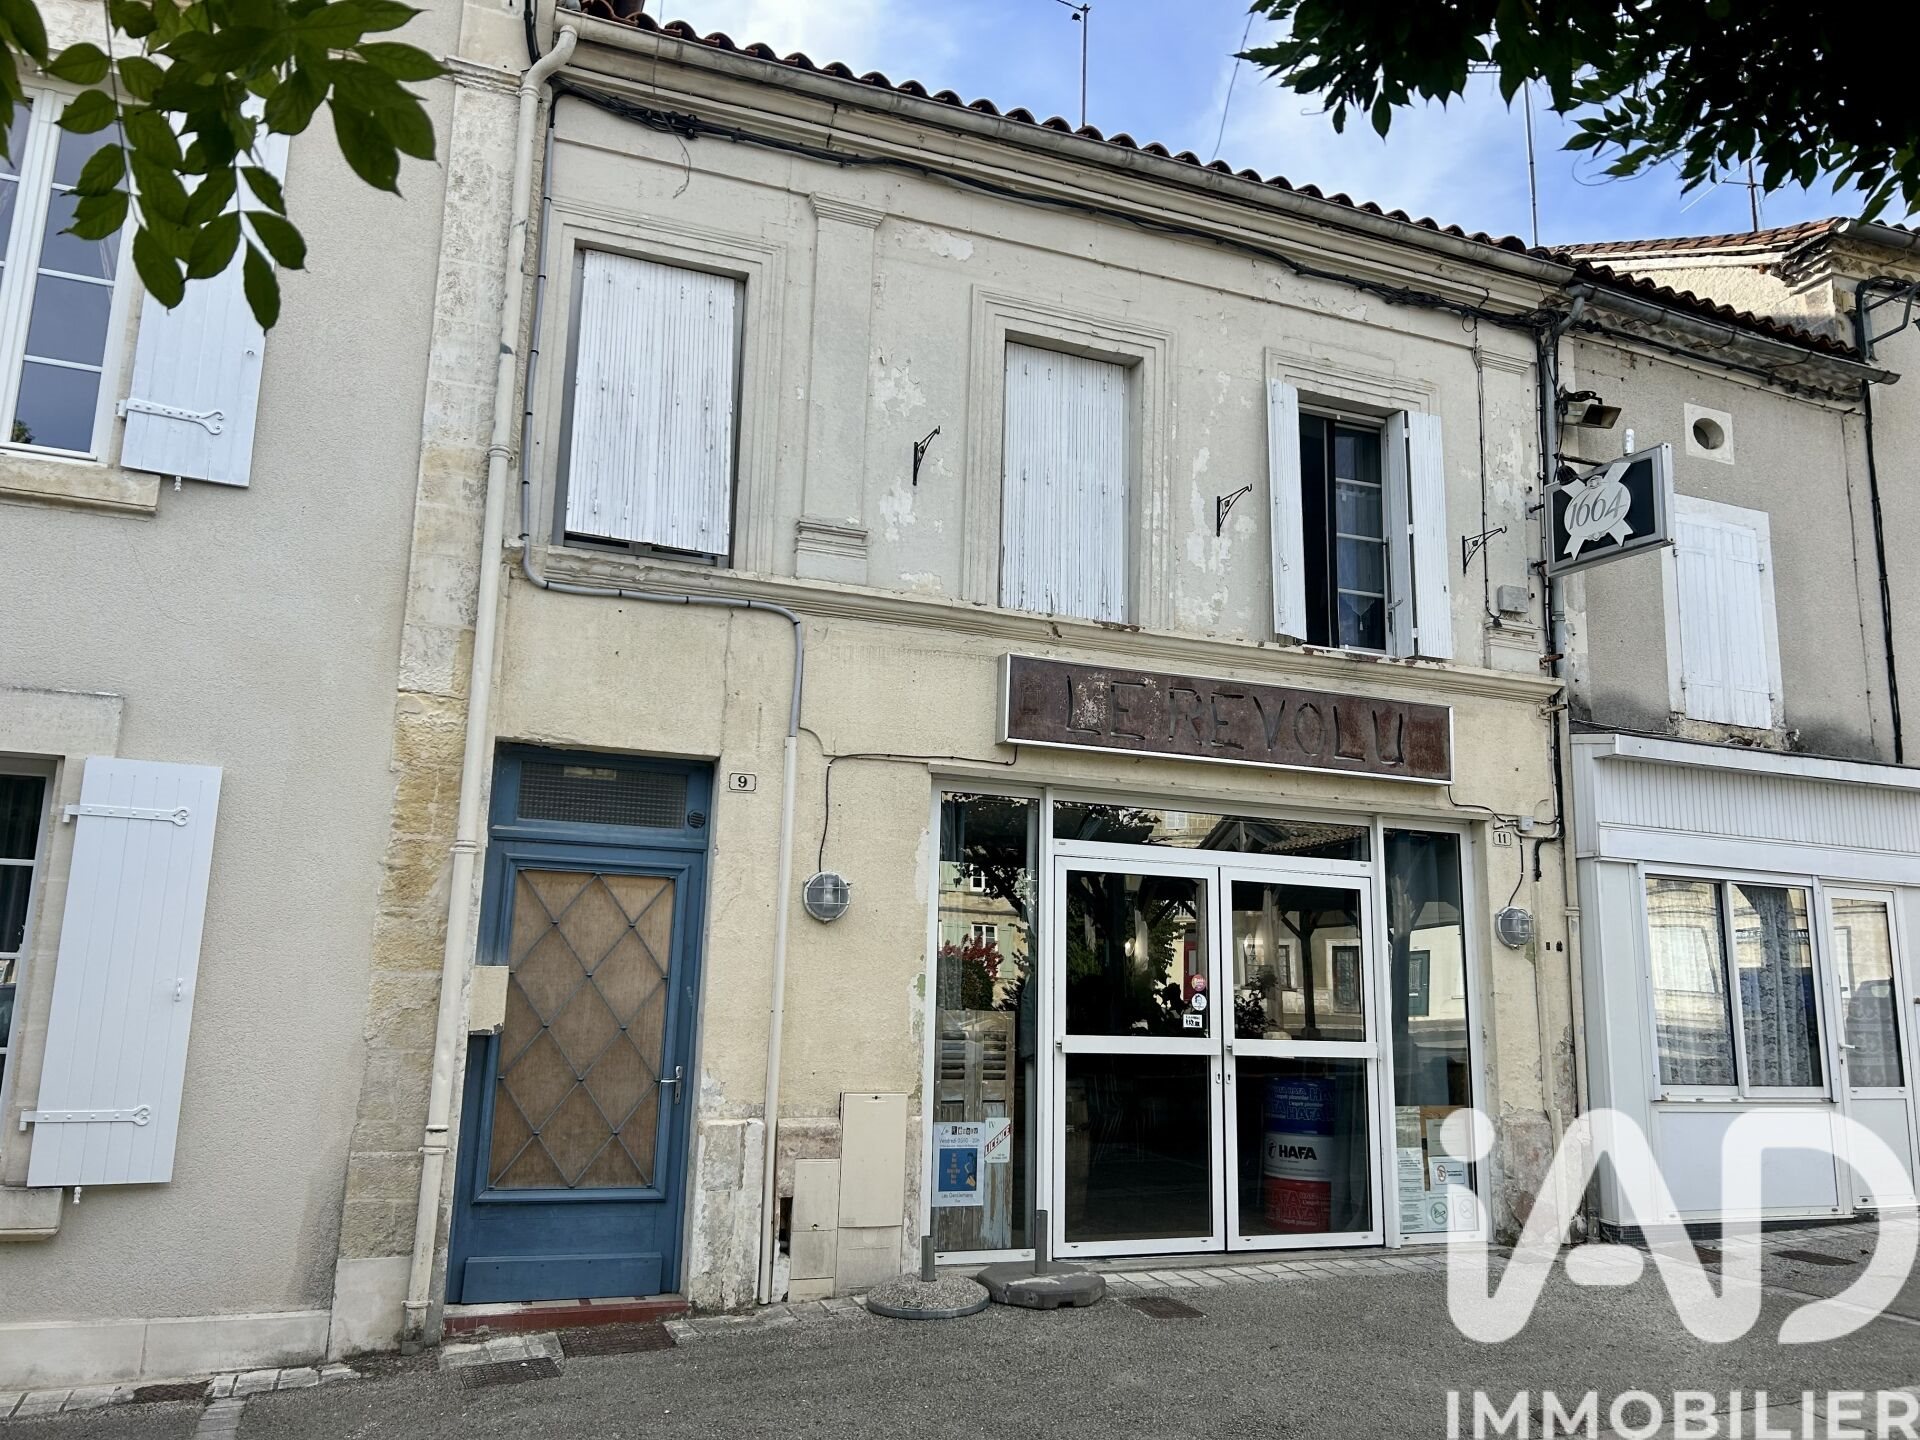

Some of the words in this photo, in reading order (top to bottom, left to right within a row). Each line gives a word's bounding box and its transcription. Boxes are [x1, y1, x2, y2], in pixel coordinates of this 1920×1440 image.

[1568, 487, 1628, 531] 1664
[1066, 675, 1146, 741] LE
[1168, 686, 1405, 767] REVOLU
[738, 775, 748, 788] 9
[1498, 833, 1506, 843] 11
[985, 1124, 1011, 1154] LICENCE
[1279, 1144, 1317, 1160] HAFA
